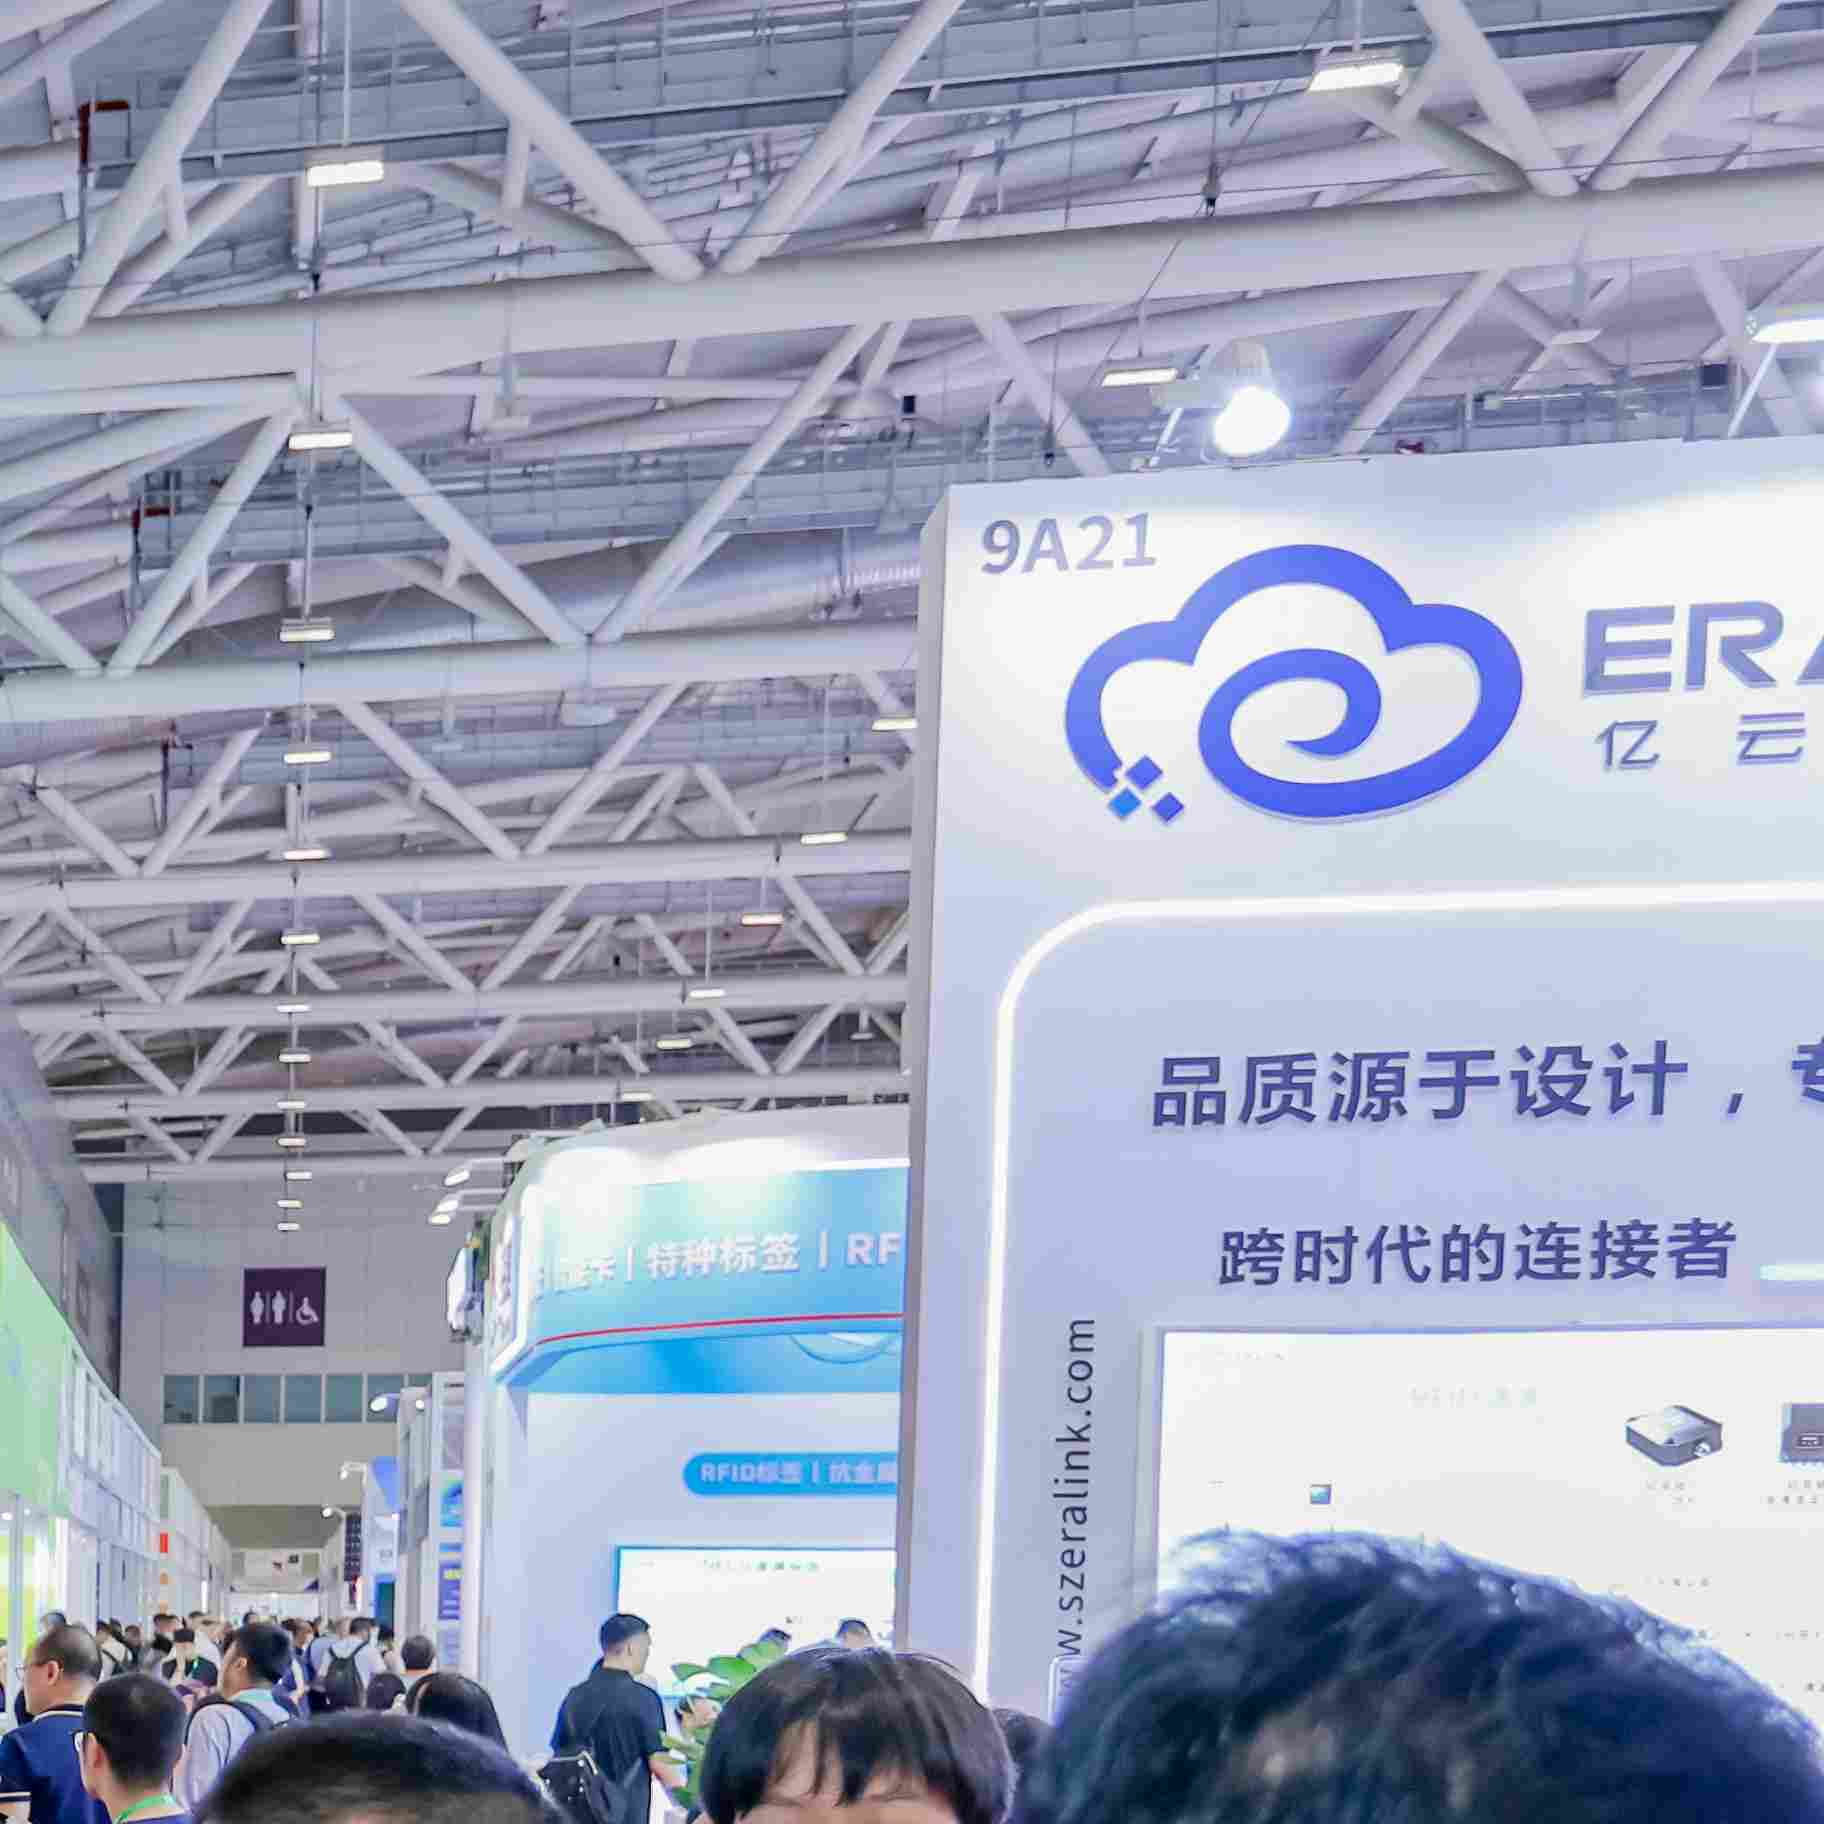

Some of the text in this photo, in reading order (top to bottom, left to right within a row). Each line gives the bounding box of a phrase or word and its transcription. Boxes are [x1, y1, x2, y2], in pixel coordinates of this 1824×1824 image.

[979, 511, 1159, 576] 9A21
[1218, 1216, 1737, 1286] 跨时代的连接者
